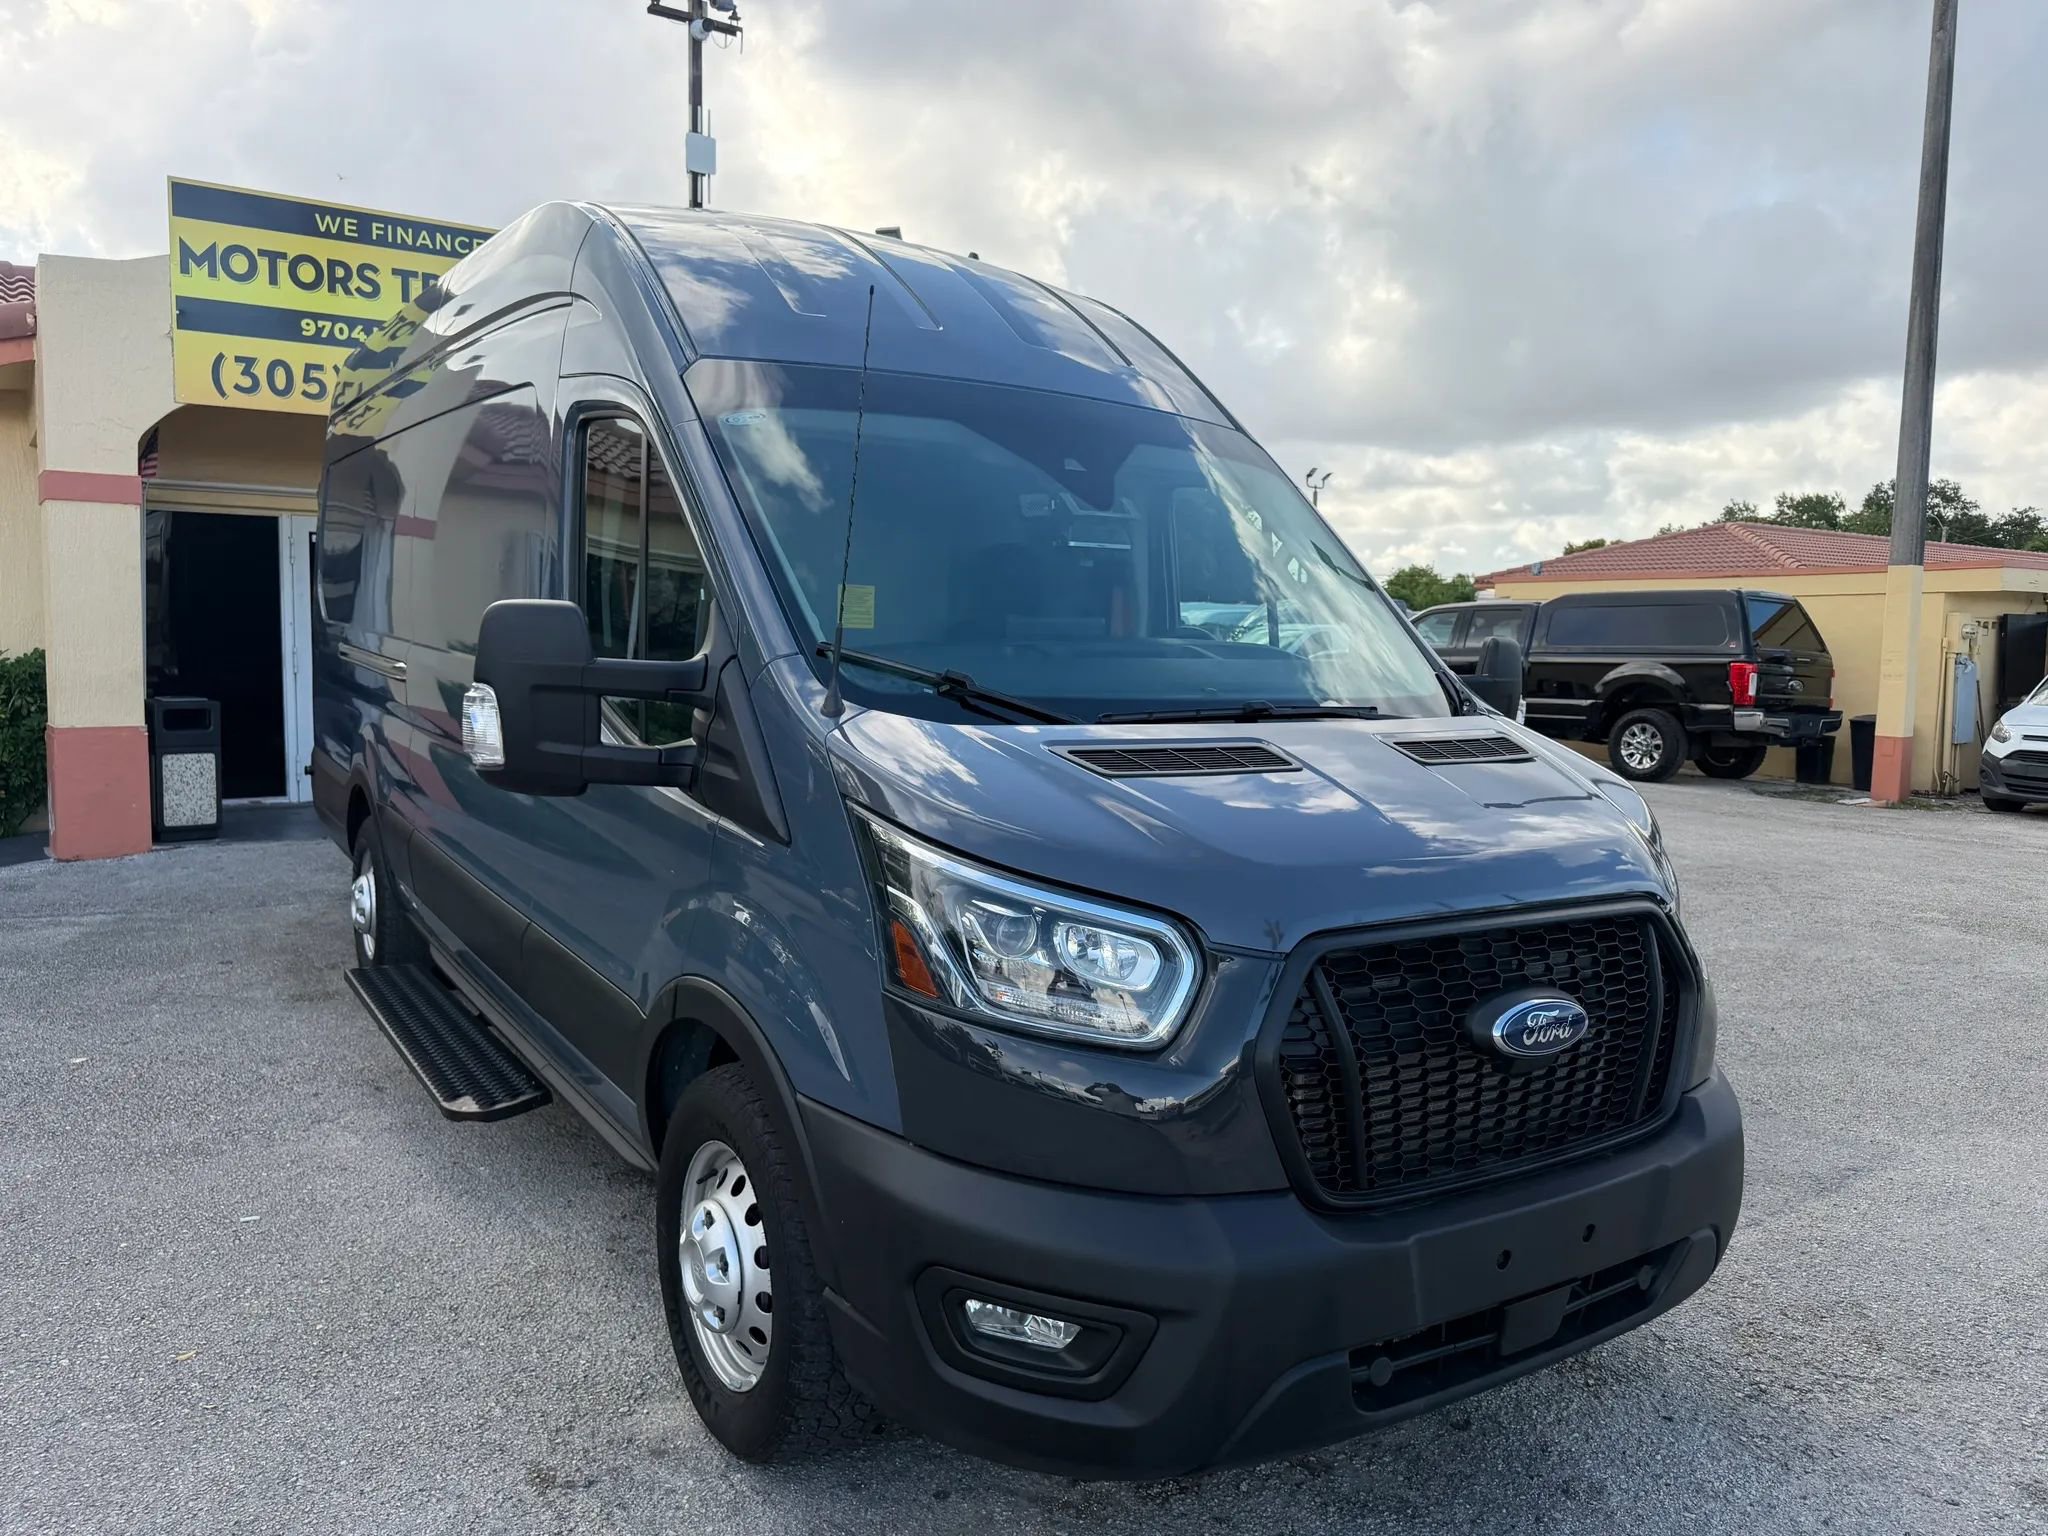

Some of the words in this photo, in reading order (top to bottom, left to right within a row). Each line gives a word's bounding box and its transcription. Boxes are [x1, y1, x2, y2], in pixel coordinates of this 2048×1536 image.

[314, 212, 359, 238] WE
[178, 236, 382, 302] MOTORS
[301, 318, 368, 343] 9704
[1522, 1009, 1573, 1046] Ford
